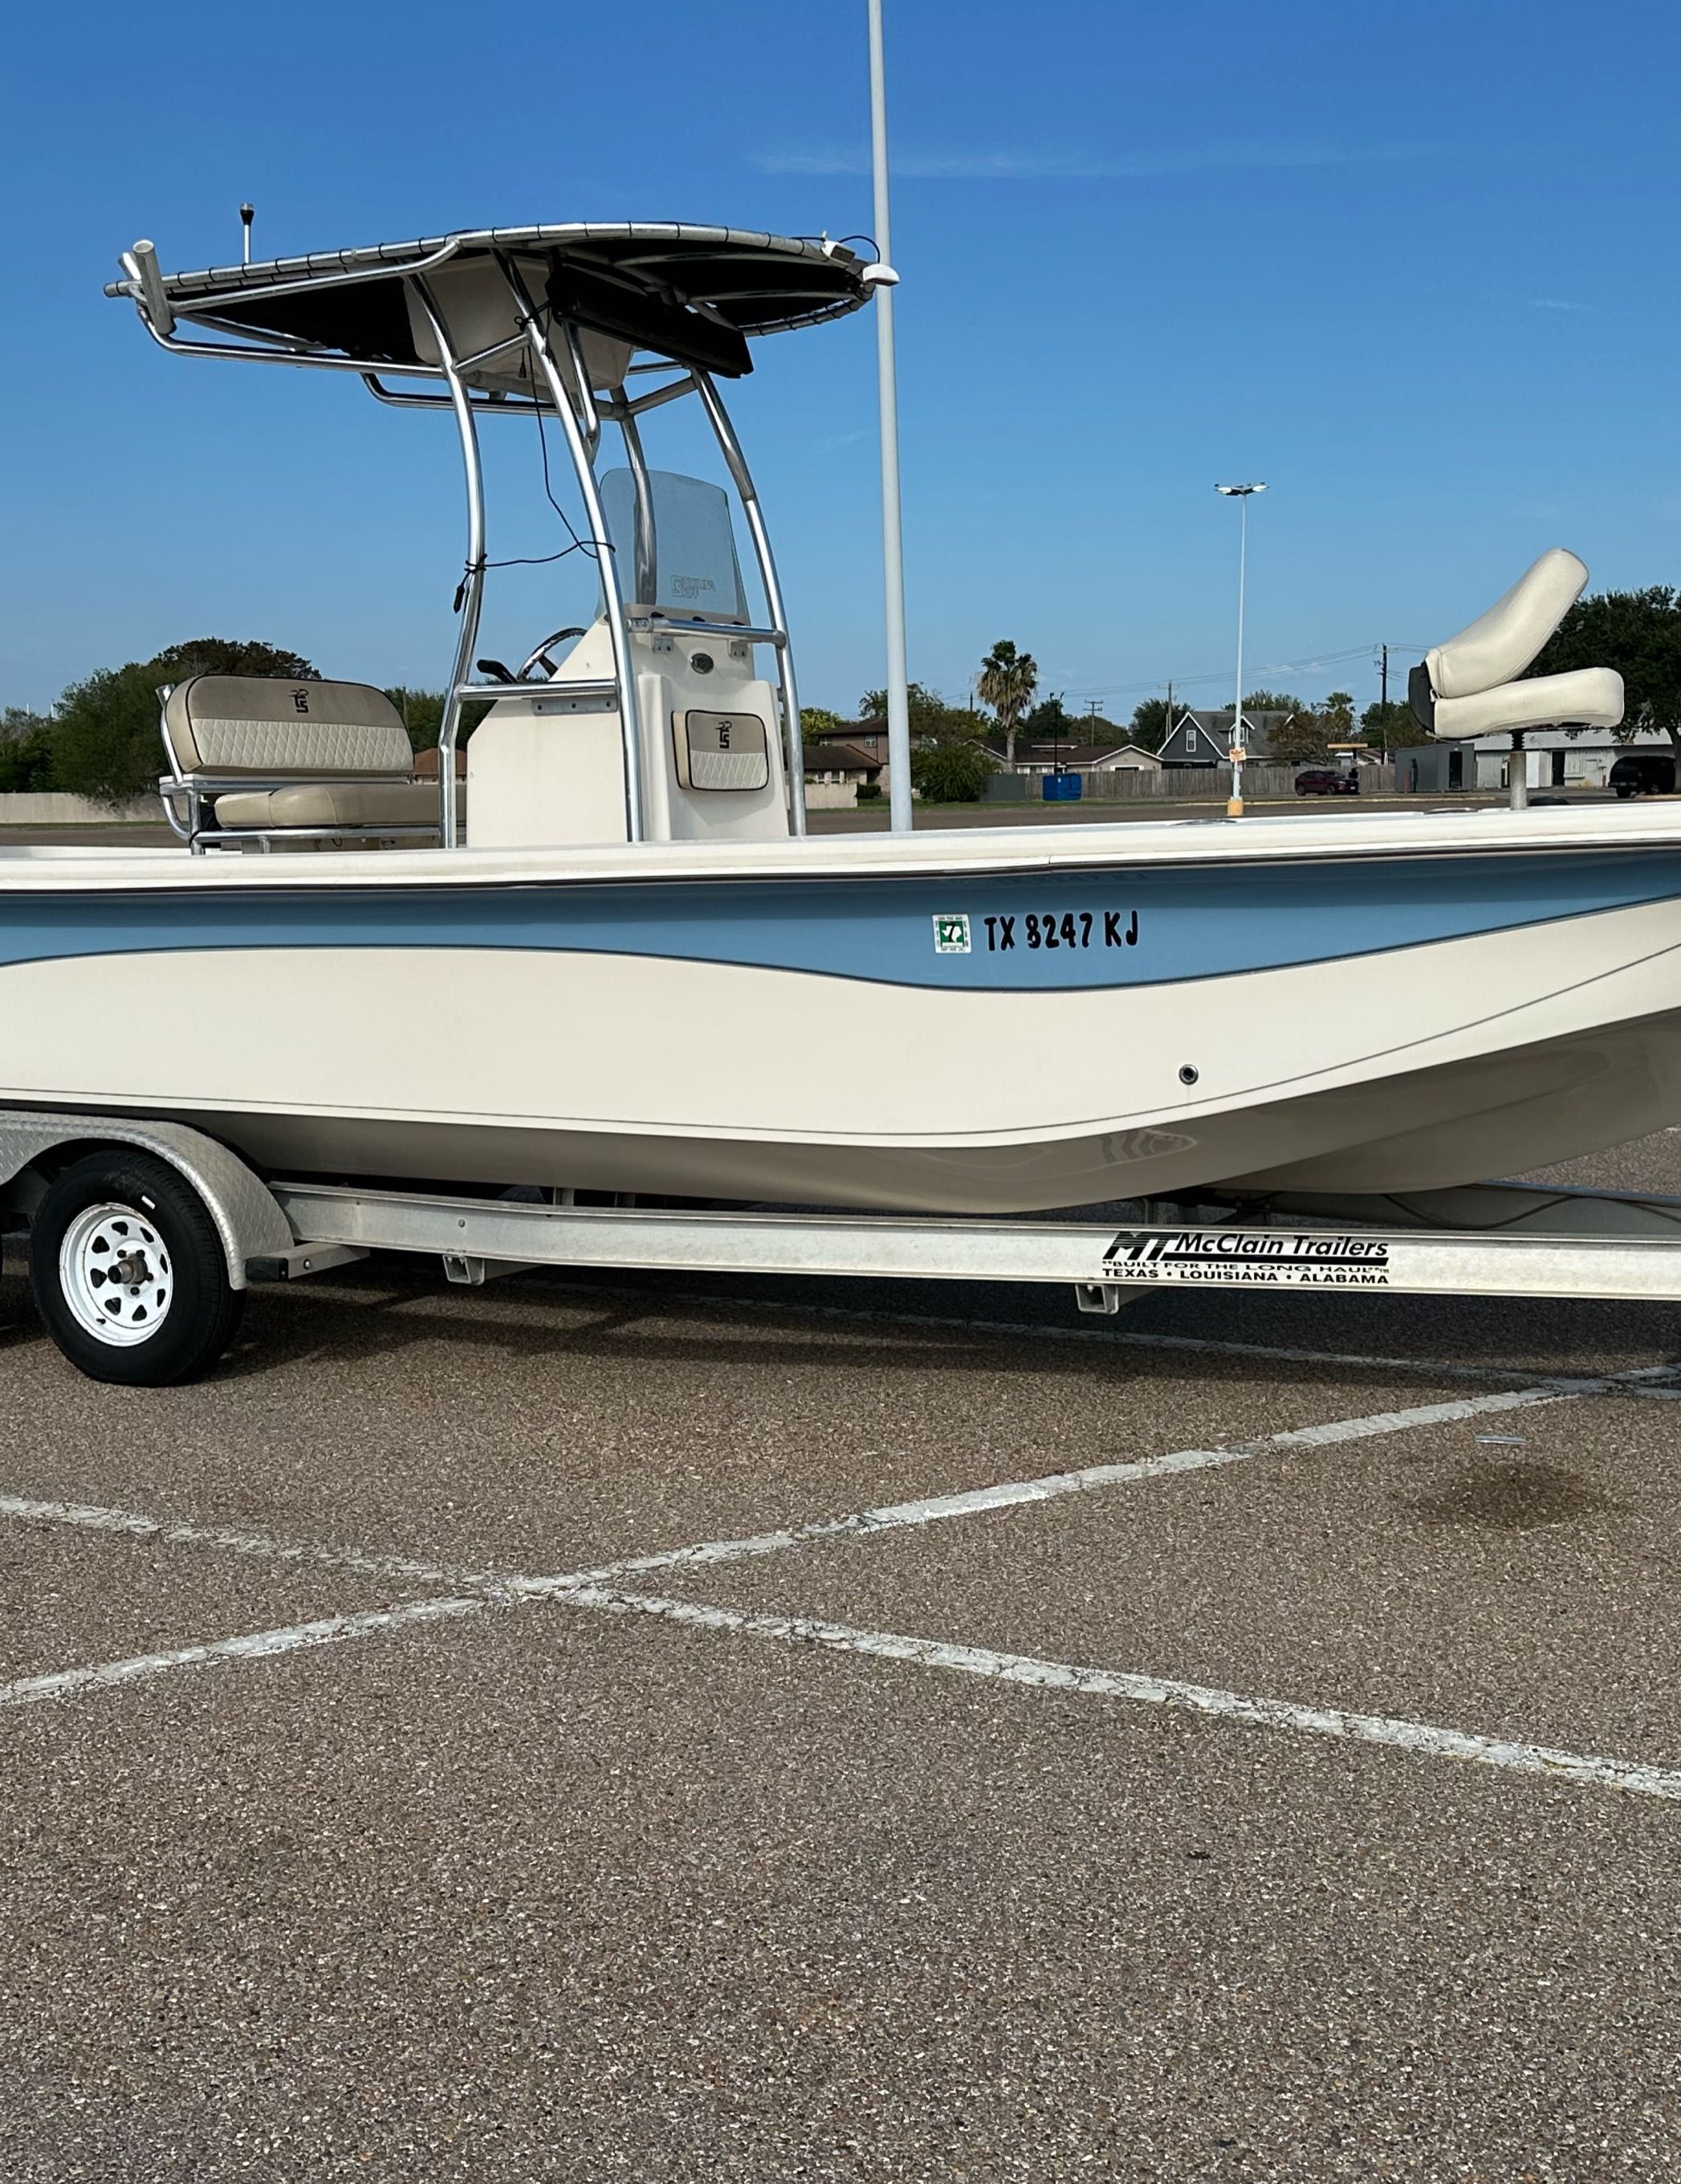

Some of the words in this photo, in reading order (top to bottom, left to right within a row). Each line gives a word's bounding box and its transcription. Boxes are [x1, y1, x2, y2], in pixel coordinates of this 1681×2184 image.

[983, 916, 1016, 951] TX
[1025, 912, 1093, 949] 8247
[1104, 911, 1138, 947] KJ
[1174, 1233, 1284, 1253] McClain
[1292, 1235, 1389, 1256] Trailers
[1102, 1268, 1158, 1278] TEXAS
[1179, 1270, 1279, 1281] LOUISIANA
[1299, 1273, 1389, 1284] ALABAMA
[1245, 1264, 1312, 1272] LONG
